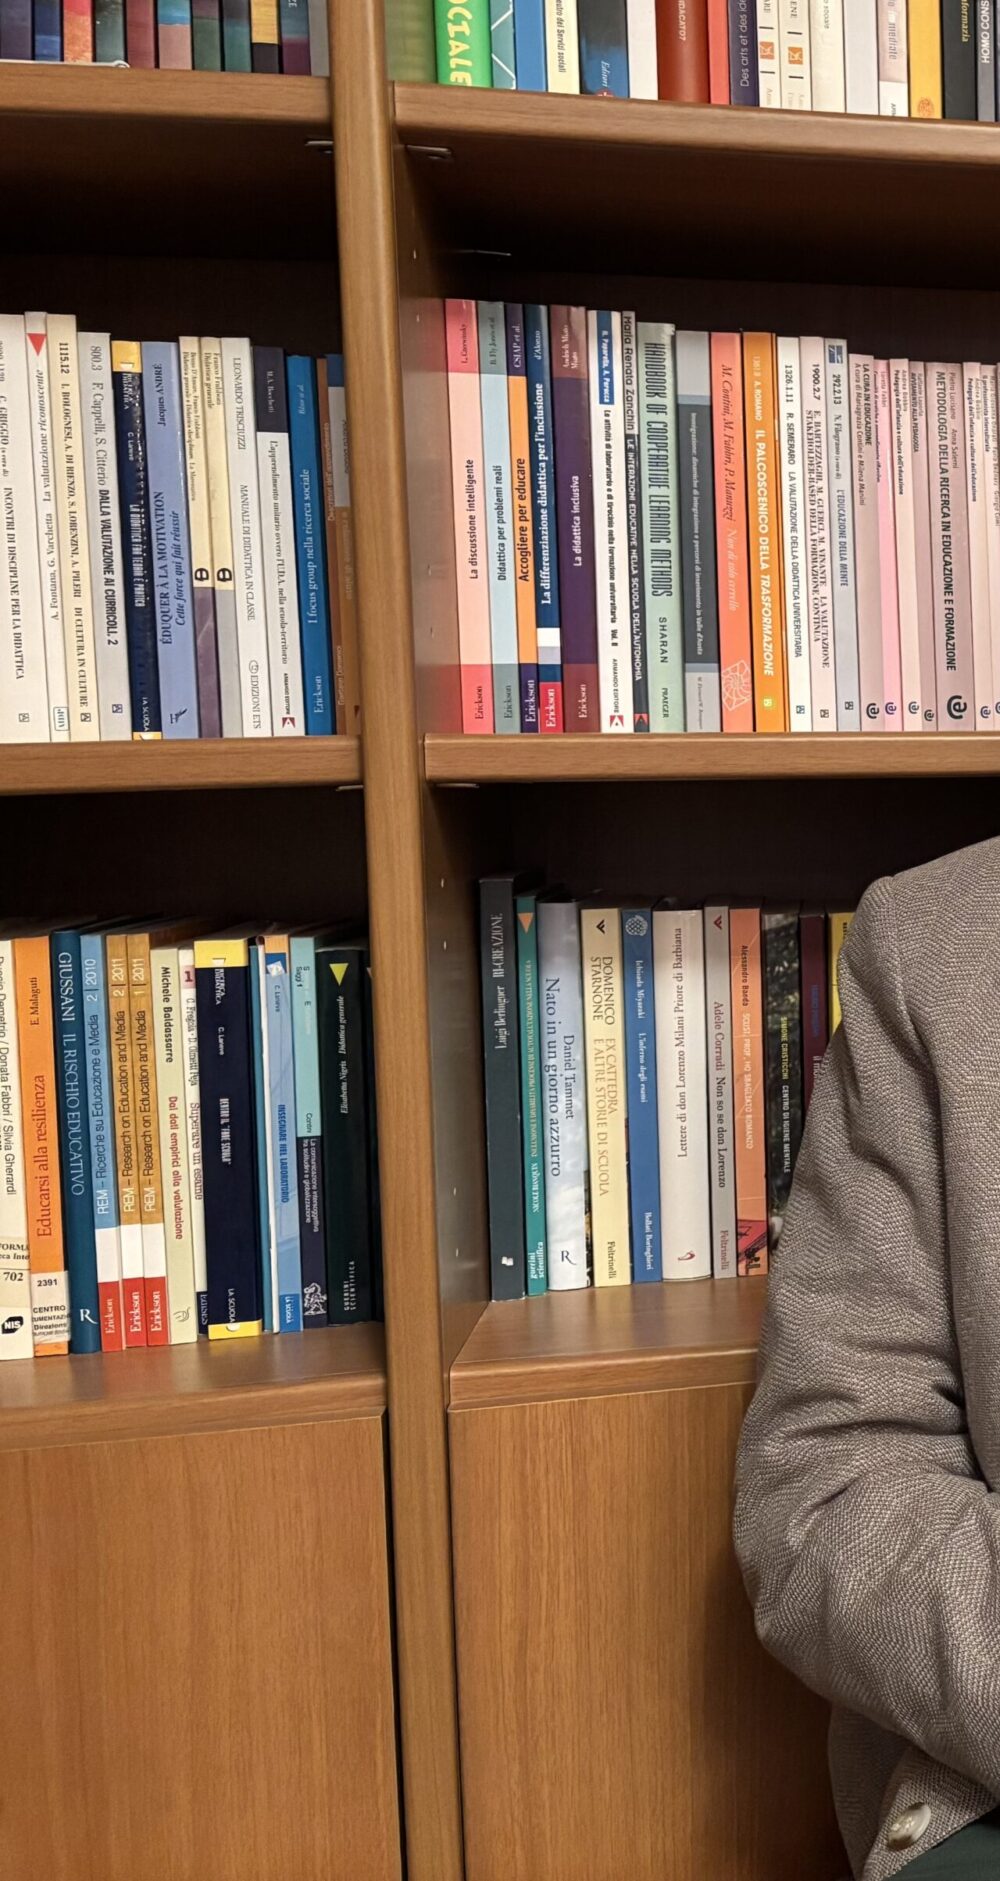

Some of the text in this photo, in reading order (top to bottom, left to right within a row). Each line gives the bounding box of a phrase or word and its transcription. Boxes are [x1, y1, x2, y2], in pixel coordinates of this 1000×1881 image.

[980, 32, 990, 62] HOMO
[91, 346, 101, 369] 800.3
[91, 393, 105, 434] Cappelli,
[233, 358, 245, 449] LEONARDO TRISCIUZZI
[936, 372, 947, 441] METODOLOGIA
[96, 446, 108, 485] Citterio
[645, 343, 672, 596] HANDBOOK OF COOPERATIVE LEARNING METHODS
[938, 444, 948, 474] DELLA
[98, 489, 110, 515] DALLA
[300, 469, 310, 499] sociale
[533, 383, 550, 603] La differenziazione didattica per l'inclusione
[940, 477, 950, 518] RICERCA
[154, 492, 166, 560] MOTIVATION
[304, 502, 312, 533] ricerca
[465, 459, 478, 578] La discussione intelligente
[517, 458, 530, 581] Accogliere per educare
[941, 521, 950, 531] IN
[100, 519, 113, 574] VALUTAZIONE
[240, 484, 254, 620] MANUALE DI DIDATTICA IN CLASSE
[303, 536, 313, 558] nella
[755, 430, 774, 675] IL PALCOSCENICO DELLA TRASFORMAZIONE
[941, 535, 952, 595] EDUCAZIONE
[4, 487, 23, 678] INCONTRI DI DISCIPLINE PER LA DIDATTICA
[104, 577, 114, 585] AI
[158, 564, 168, 577] LA
[307, 561, 317, 589] group
[104, 589, 117, 636] CURRICOLI.
[159, 592, 172, 643] ÉDUQUER
[306, 592, 316, 616] focus
[658, 617, 667, 662] SHARAN
[944, 608, 955, 670] FORMAZIONE
[250, 675, 260, 728] EDIZIONI ETS
[525, 679, 536, 722] Erickson
[590, 956, 602, 1020] STARNONE
[602, 956, 613, 1024] DOMENICO
[161, 967, 172, 1062] Michele Baldassarre
[594, 1048, 605, 1082] ALTRE
[672, 928, 687, 1157] Lettere di don Lorenzo Milani Priore di Barbiana
[58, 952, 84, 1195] GIUSSANI IL RISCHIO EDUCATIVO
[544, 978, 561, 1176] Nato in un giorno azzurro
[563, 1035, 575, 1118] Daniel Tammet
[605, 1038, 617, 1113] EX CATTEDRA
[596, 1087, 606, 1126] STORIE
[33, 1075, 51, 1236] Educarsi alla resilienza
[597, 1132, 607, 1144] DI
[598, 1150, 609, 1196] SCUOLA
[3, 1272, 23, 1281] 702
[37, 1279, 58, 1287] 2391
[4, 1320, 21, 1330] NIS
[32, 1305, 66, 1313] CENTRO
[105, 1298, 115, 1334] Erickson
[130, 1292, 142, 1332] Erickson
[151, 1291, 162, 1331] Erickson
